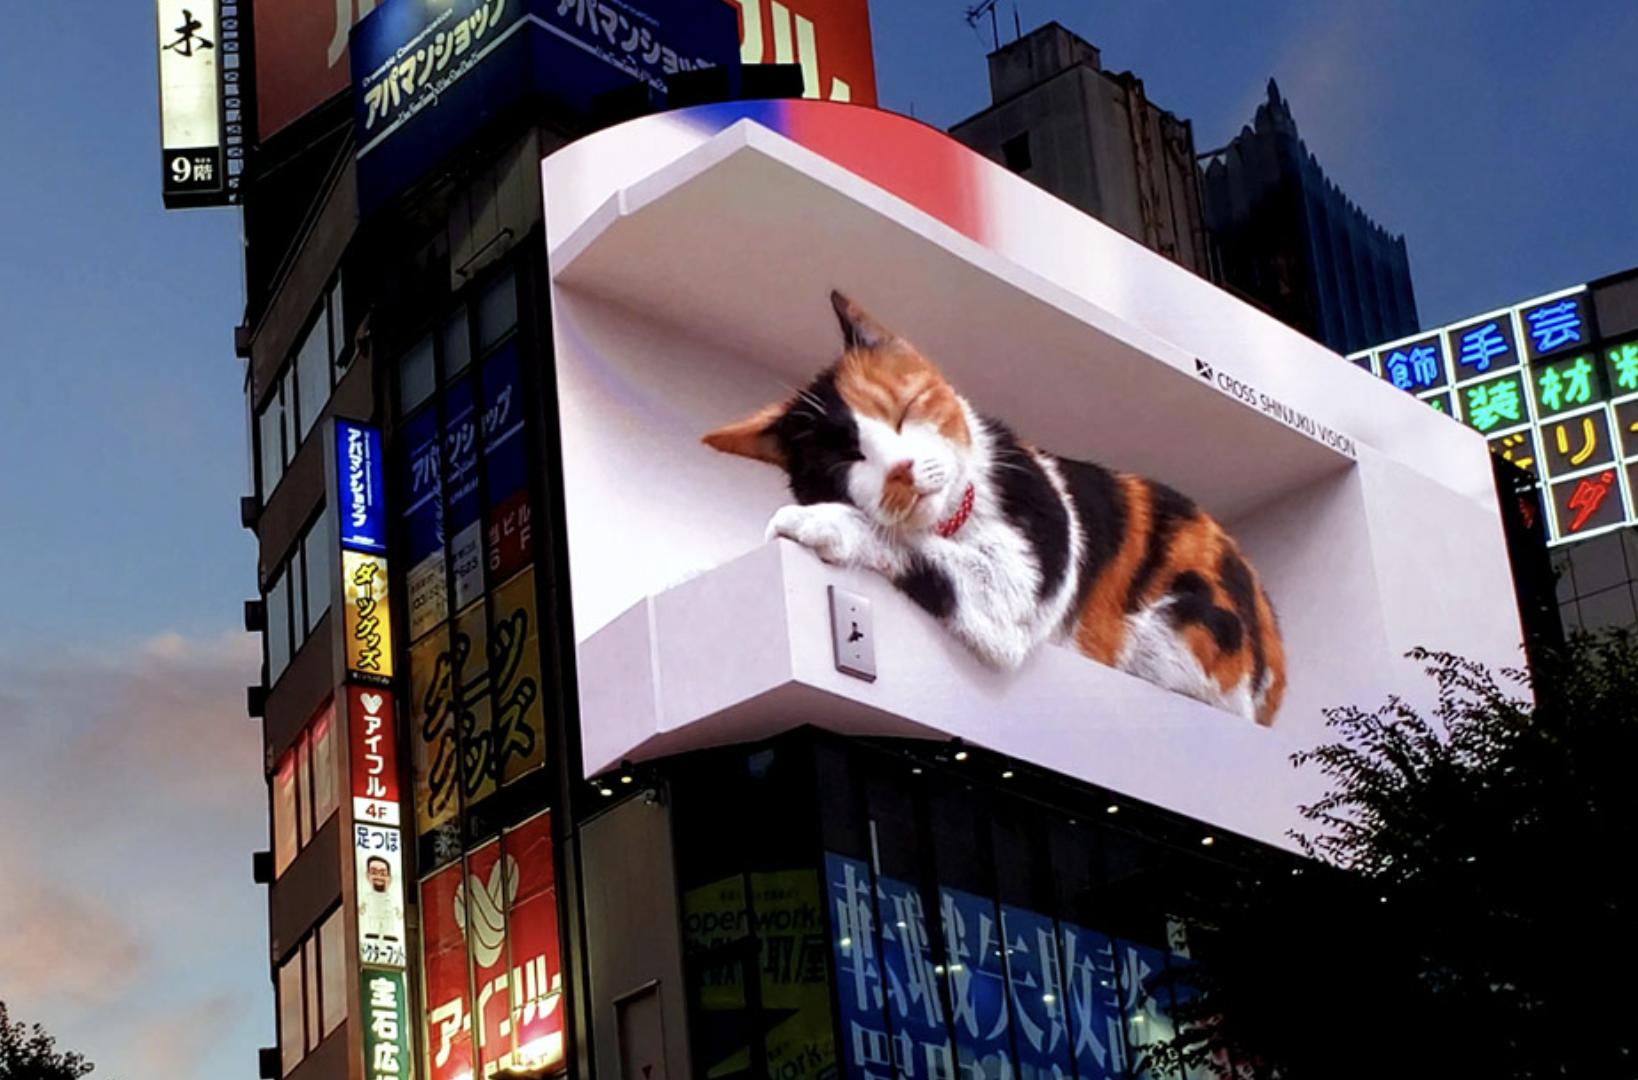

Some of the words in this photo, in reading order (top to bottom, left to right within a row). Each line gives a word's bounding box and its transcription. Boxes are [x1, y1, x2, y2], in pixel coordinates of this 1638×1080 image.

[163, 9, 214, 57] 木
[171, 156, 213, 183] 9階
[1387, 302, 1581, 391] 飾手芸
[1425, 345, 1638, 431] 装材
[411, 384, 513, 493] アパンシップ
[1217, 372, 1257, 406] CROSS
[1260, 393, 1315, 436] SHINJUKU
[1317, 423, 1357, 457] VISION
[353, 561, 382, 671] ダーツグッズ
[363, 716, 387, 798] アイフル
[365, 803, 387, 819] 4F
[370, 977, 400, 1080] 宝石広
[431, 954, 562, 1069] アイフル
